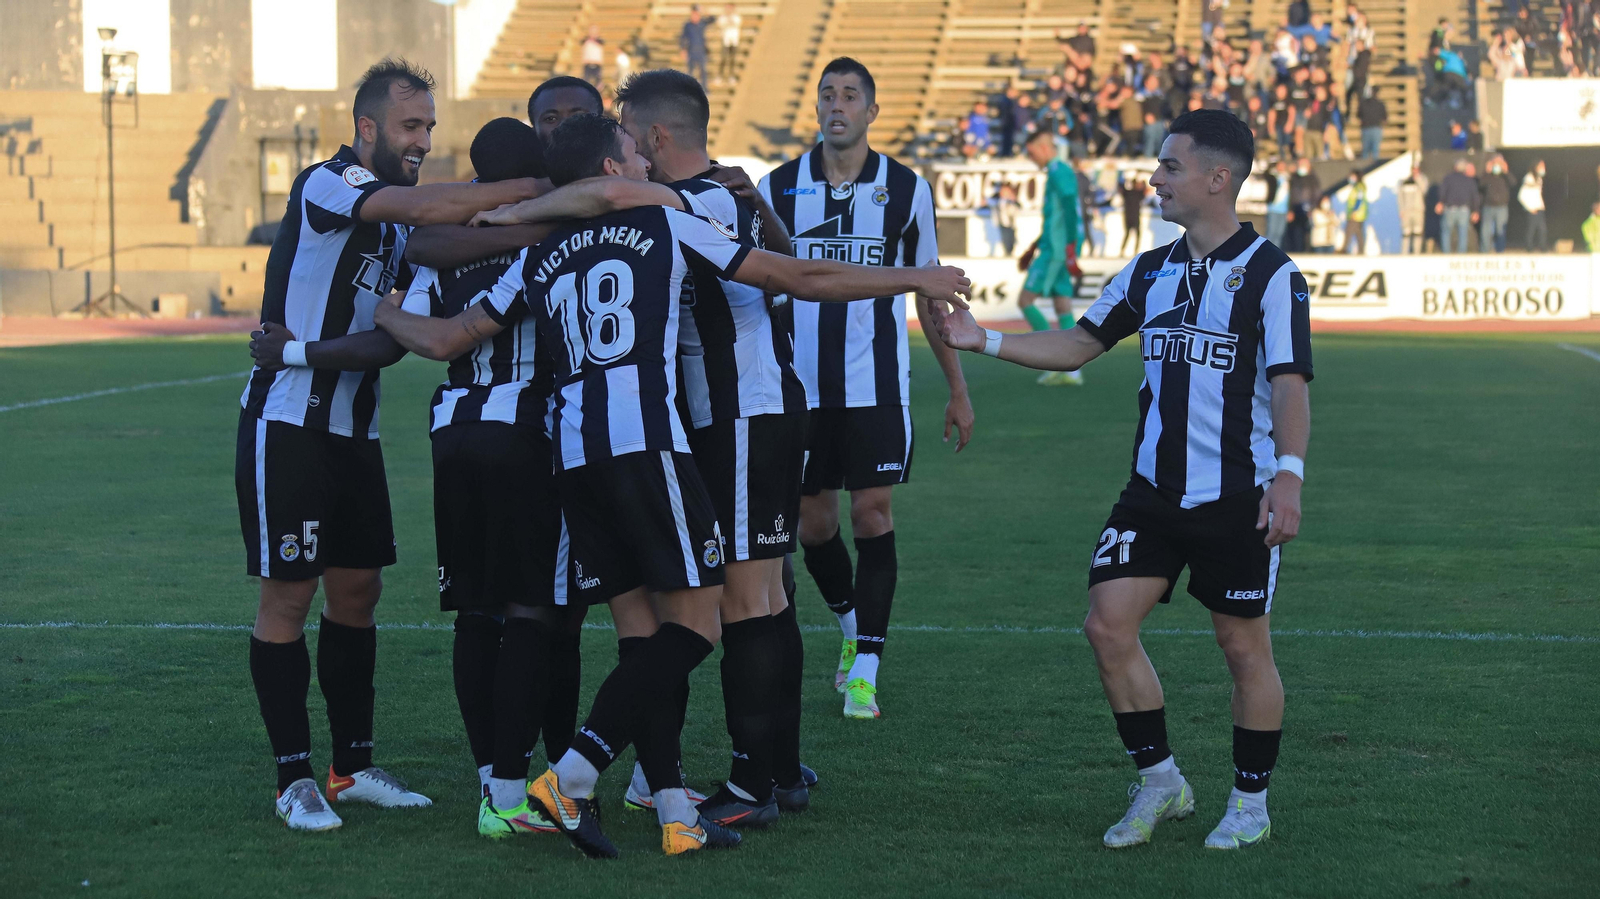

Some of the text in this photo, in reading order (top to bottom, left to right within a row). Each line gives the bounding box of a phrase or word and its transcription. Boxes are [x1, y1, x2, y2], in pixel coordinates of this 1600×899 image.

[598, 226, 655, 257] MENA
[1143, 268, 1177, 279] LEGEA
[545, 259, 635, 377] 18
[1422, 286, 1564, 316] BARROSO
[1139, 330, 1238, 373] LOTUS
[303, 521, 319, 562] 5
[713, 520, 725, 564] 1
[757, 534, 775, 544] Ruiz
[1093, 527, 1137, 568] 21
[1226, 589, 1265, 600] LEGEA
[580, 726, 614, 760] LEGEA
